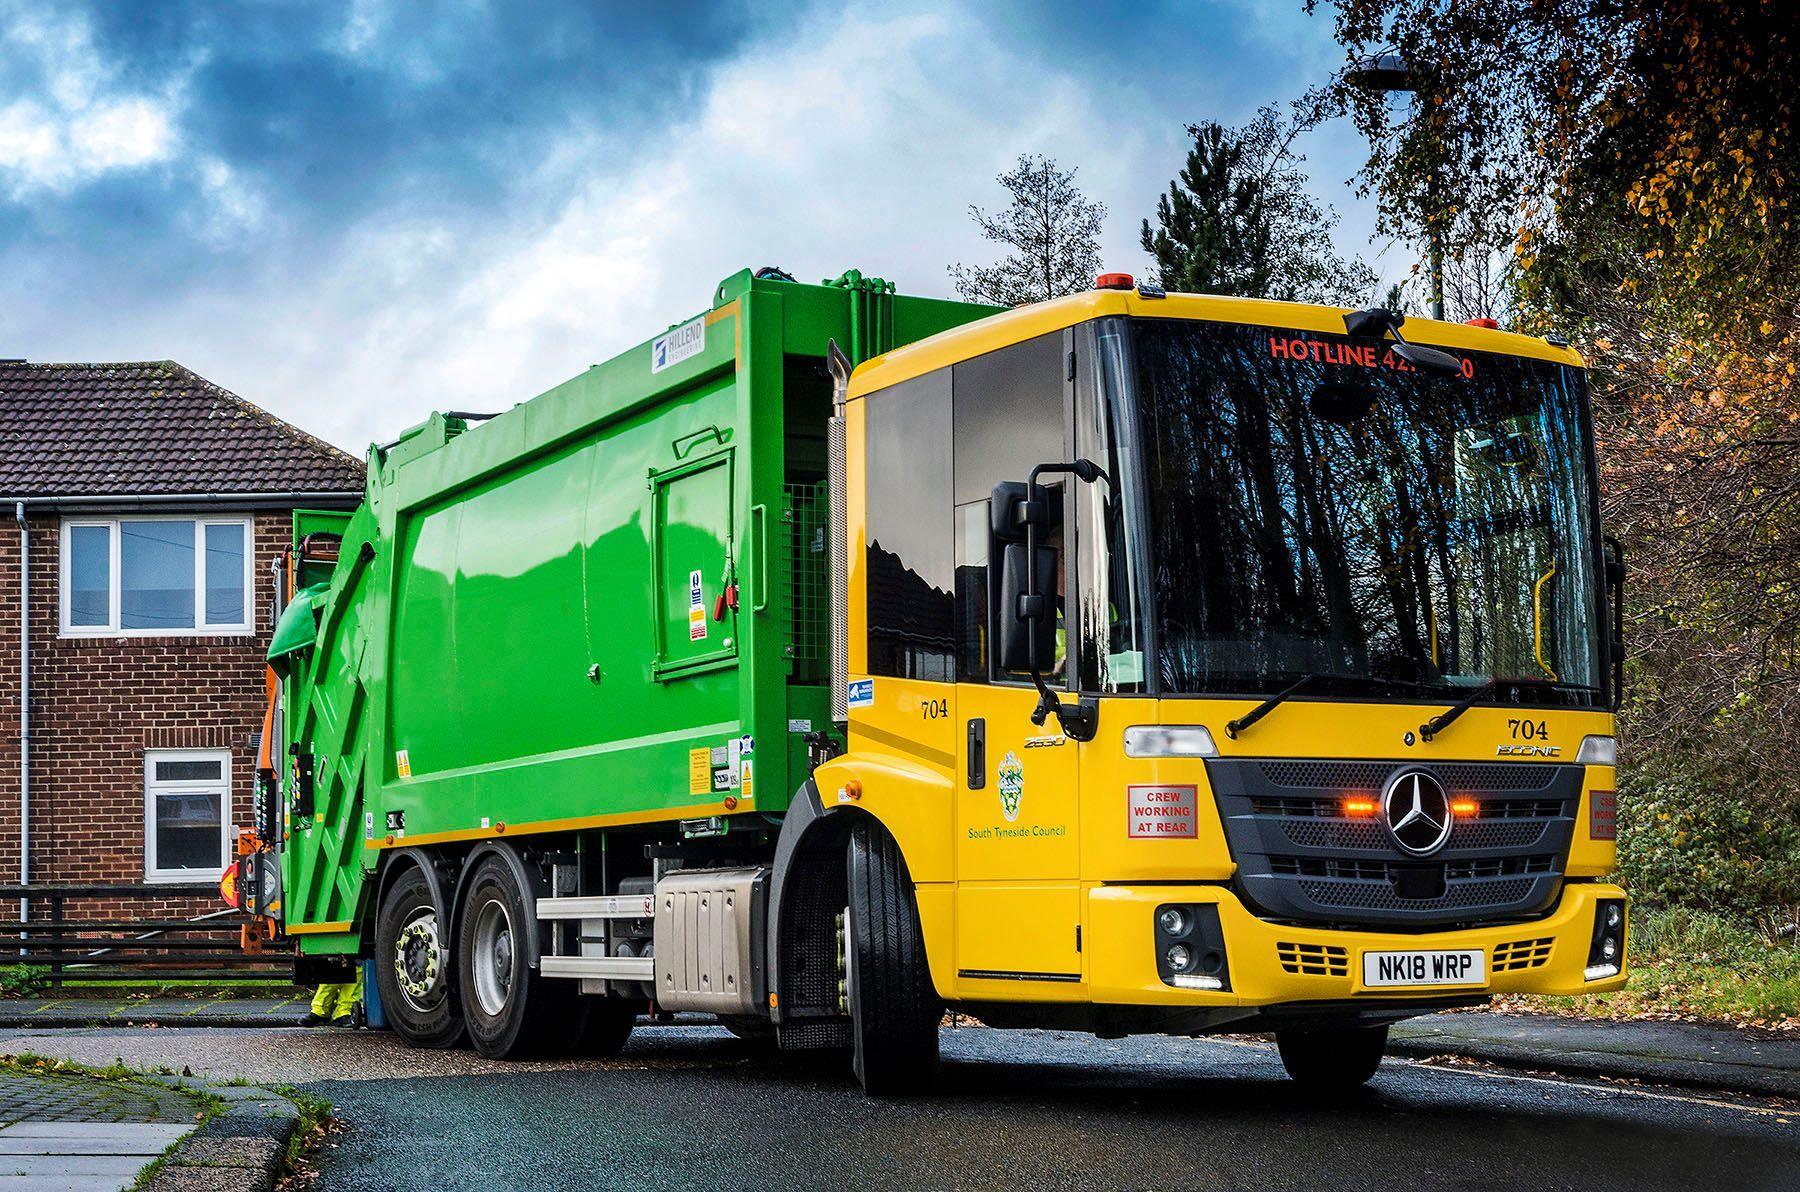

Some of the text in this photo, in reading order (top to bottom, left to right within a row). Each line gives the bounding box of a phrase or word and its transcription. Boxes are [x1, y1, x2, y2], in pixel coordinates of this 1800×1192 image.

[668, 322, 702, 352] HILLEND
[1269, 337, 1377, 368] HOTLINE
[921, 699, 948, 719] 704
[1508, 718, 1549, 740] 704
[1496, 744, 1562, 757] ECONIC
[1147, 792, 1180, 802] CREW
[1134, 806, 1190, 817] WORKING
[968, 824, 1066, 840] South Tyneside Council
[1137, 822, 1187, 832] AT REAR
[1379, 954, 1472, 980] NK18 WRP
